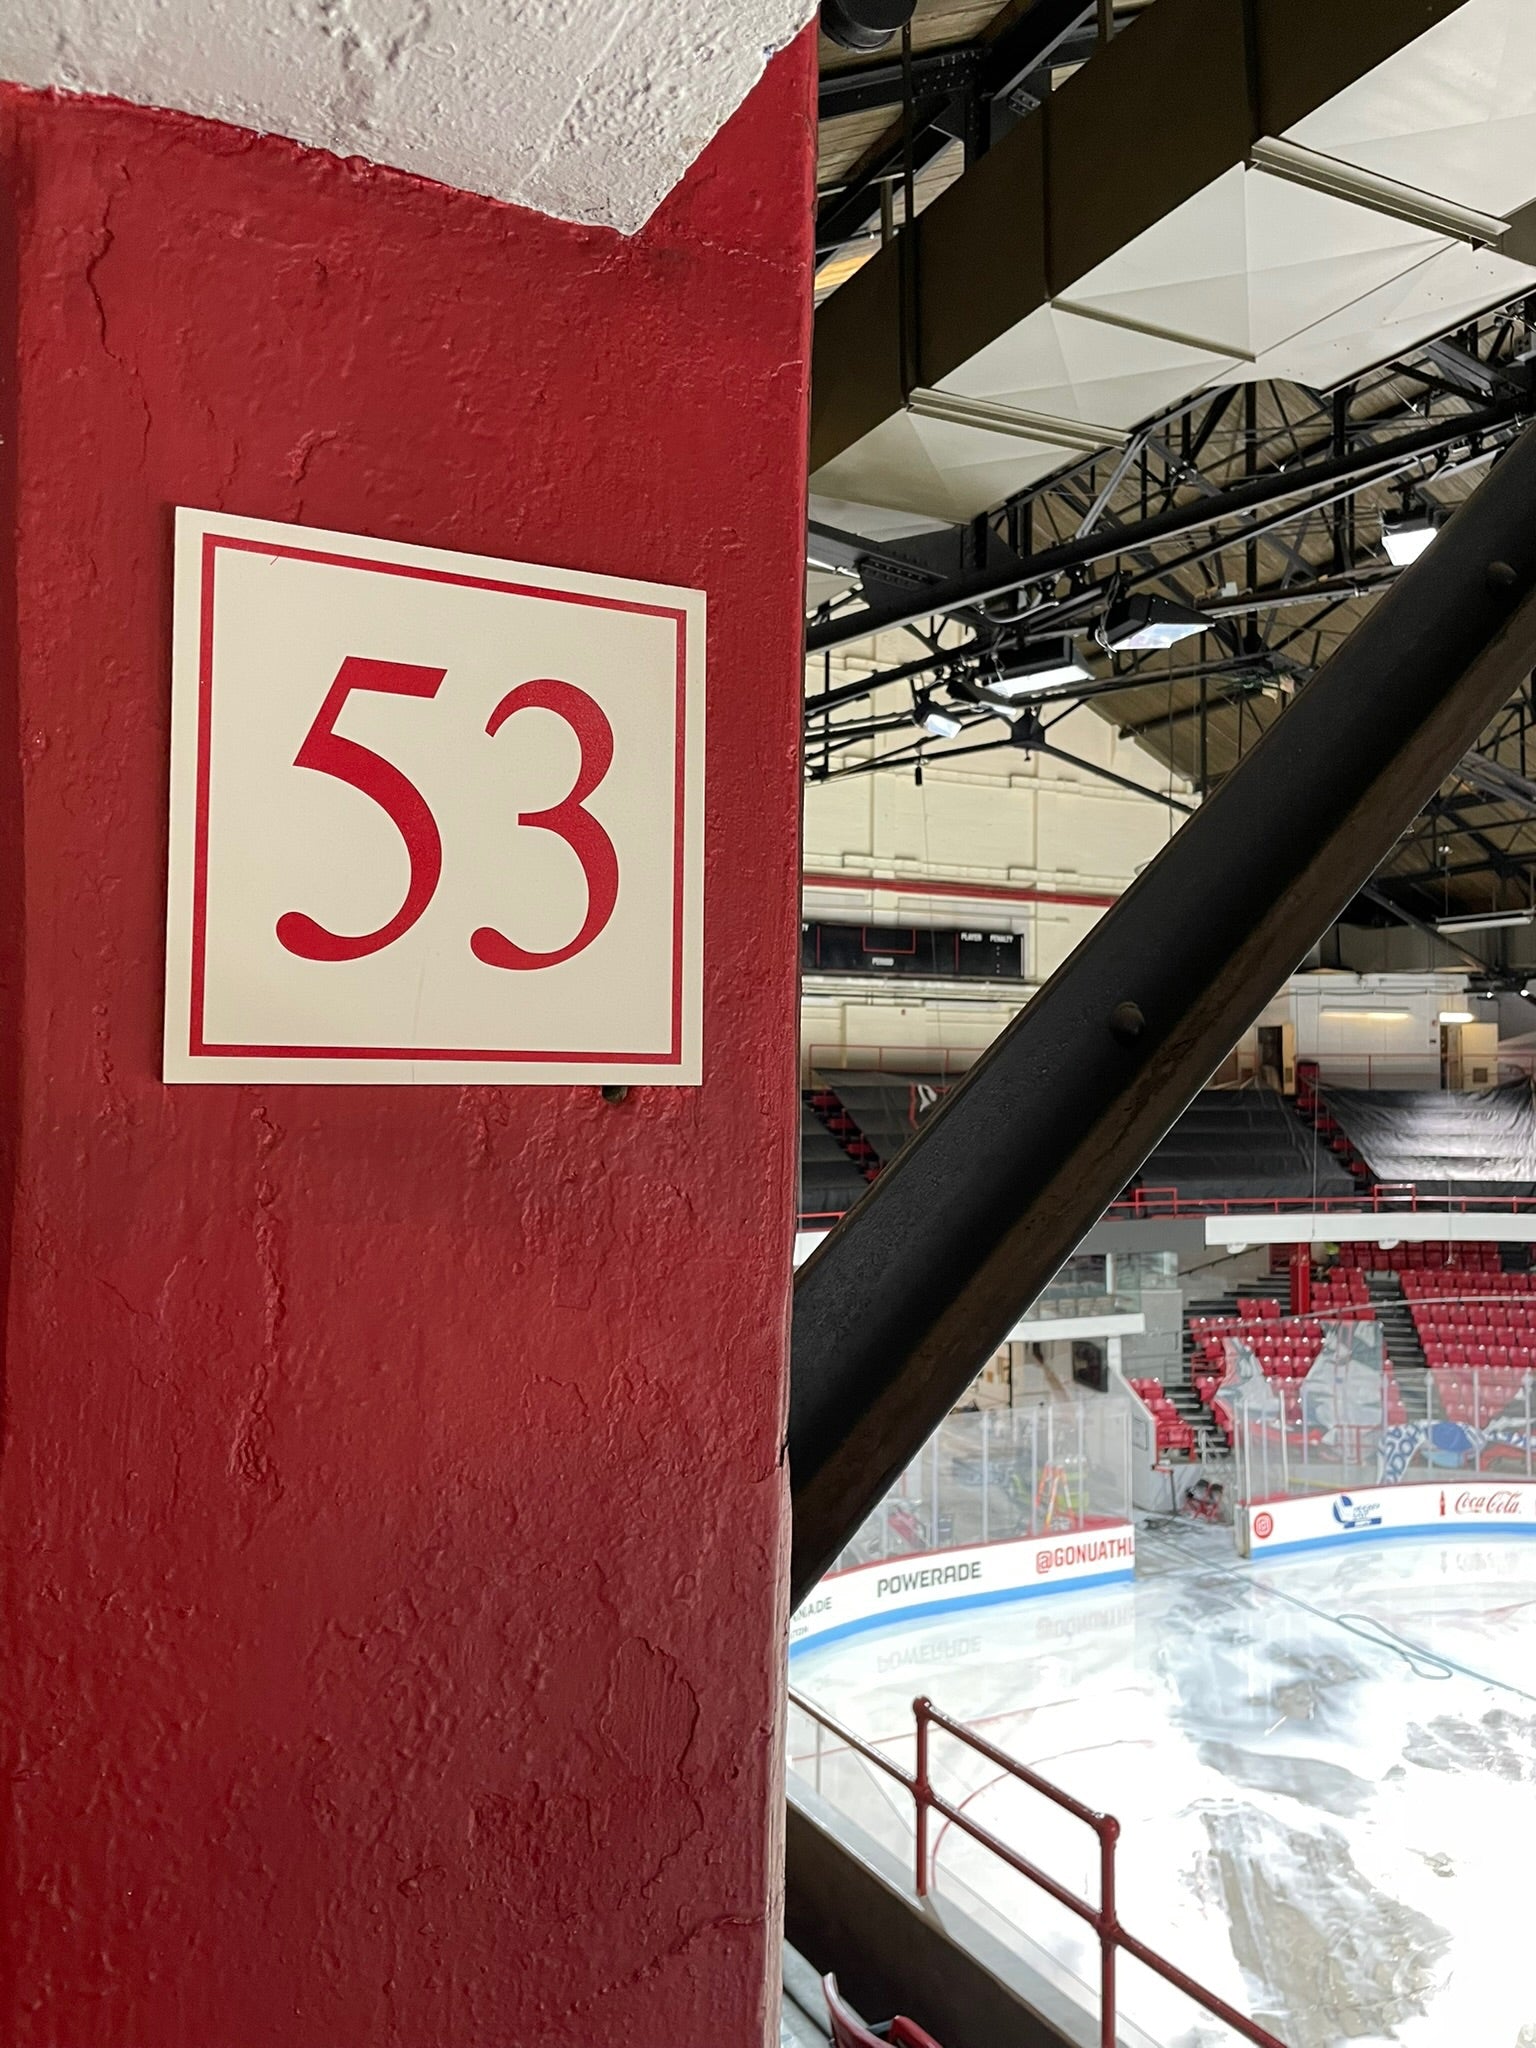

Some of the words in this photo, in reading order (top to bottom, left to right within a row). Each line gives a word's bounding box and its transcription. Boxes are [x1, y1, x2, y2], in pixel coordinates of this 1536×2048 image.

[275, 655, 620, 971] 53
[961, 932, 982, 942] PLAYER
[990, 934, 1014, 943] PENALTY
[877, 1561, 982, 1598] POWERADE
